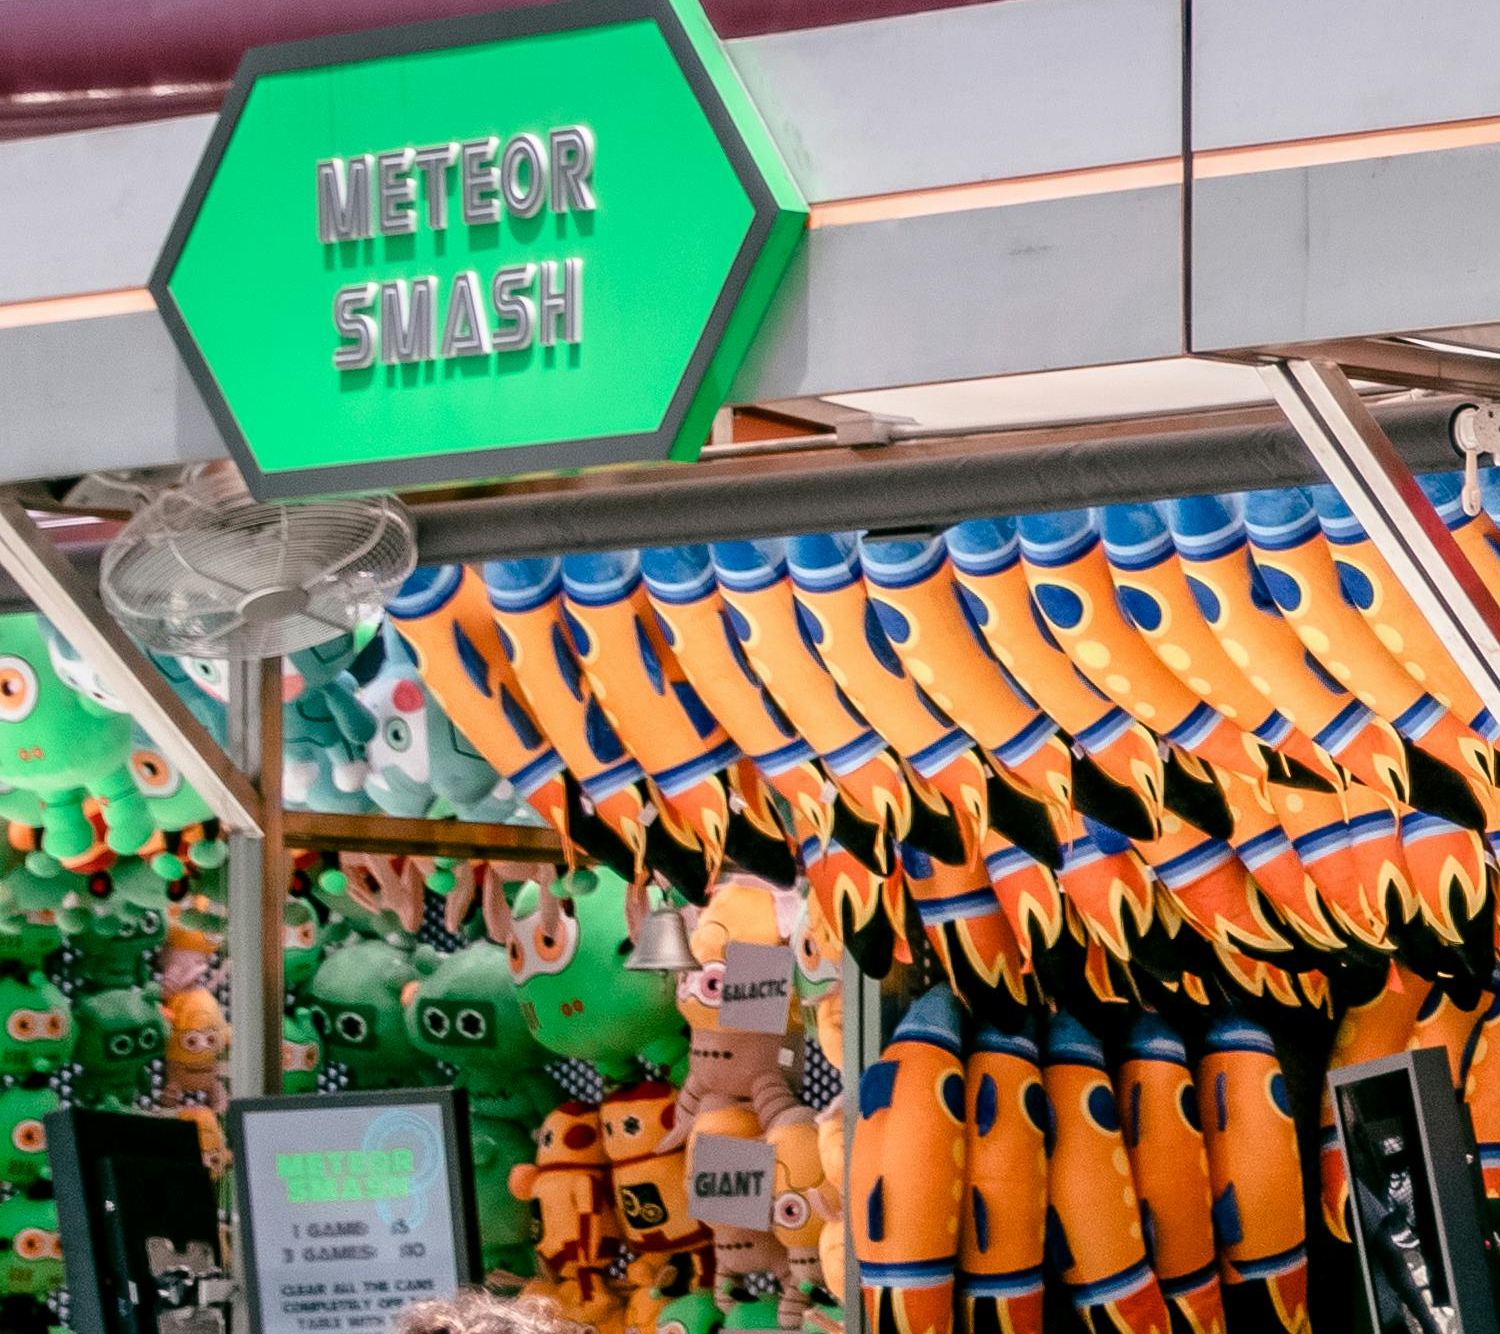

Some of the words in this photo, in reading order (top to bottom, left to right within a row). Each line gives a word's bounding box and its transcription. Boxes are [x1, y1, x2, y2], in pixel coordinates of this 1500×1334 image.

[316, 124, 596, 244] METEOR
[332, 258, 584, 371] SMASH
[722, 979, 788, 1002] GALACTIC
[694, 1170, 765, 1198] GIANT
